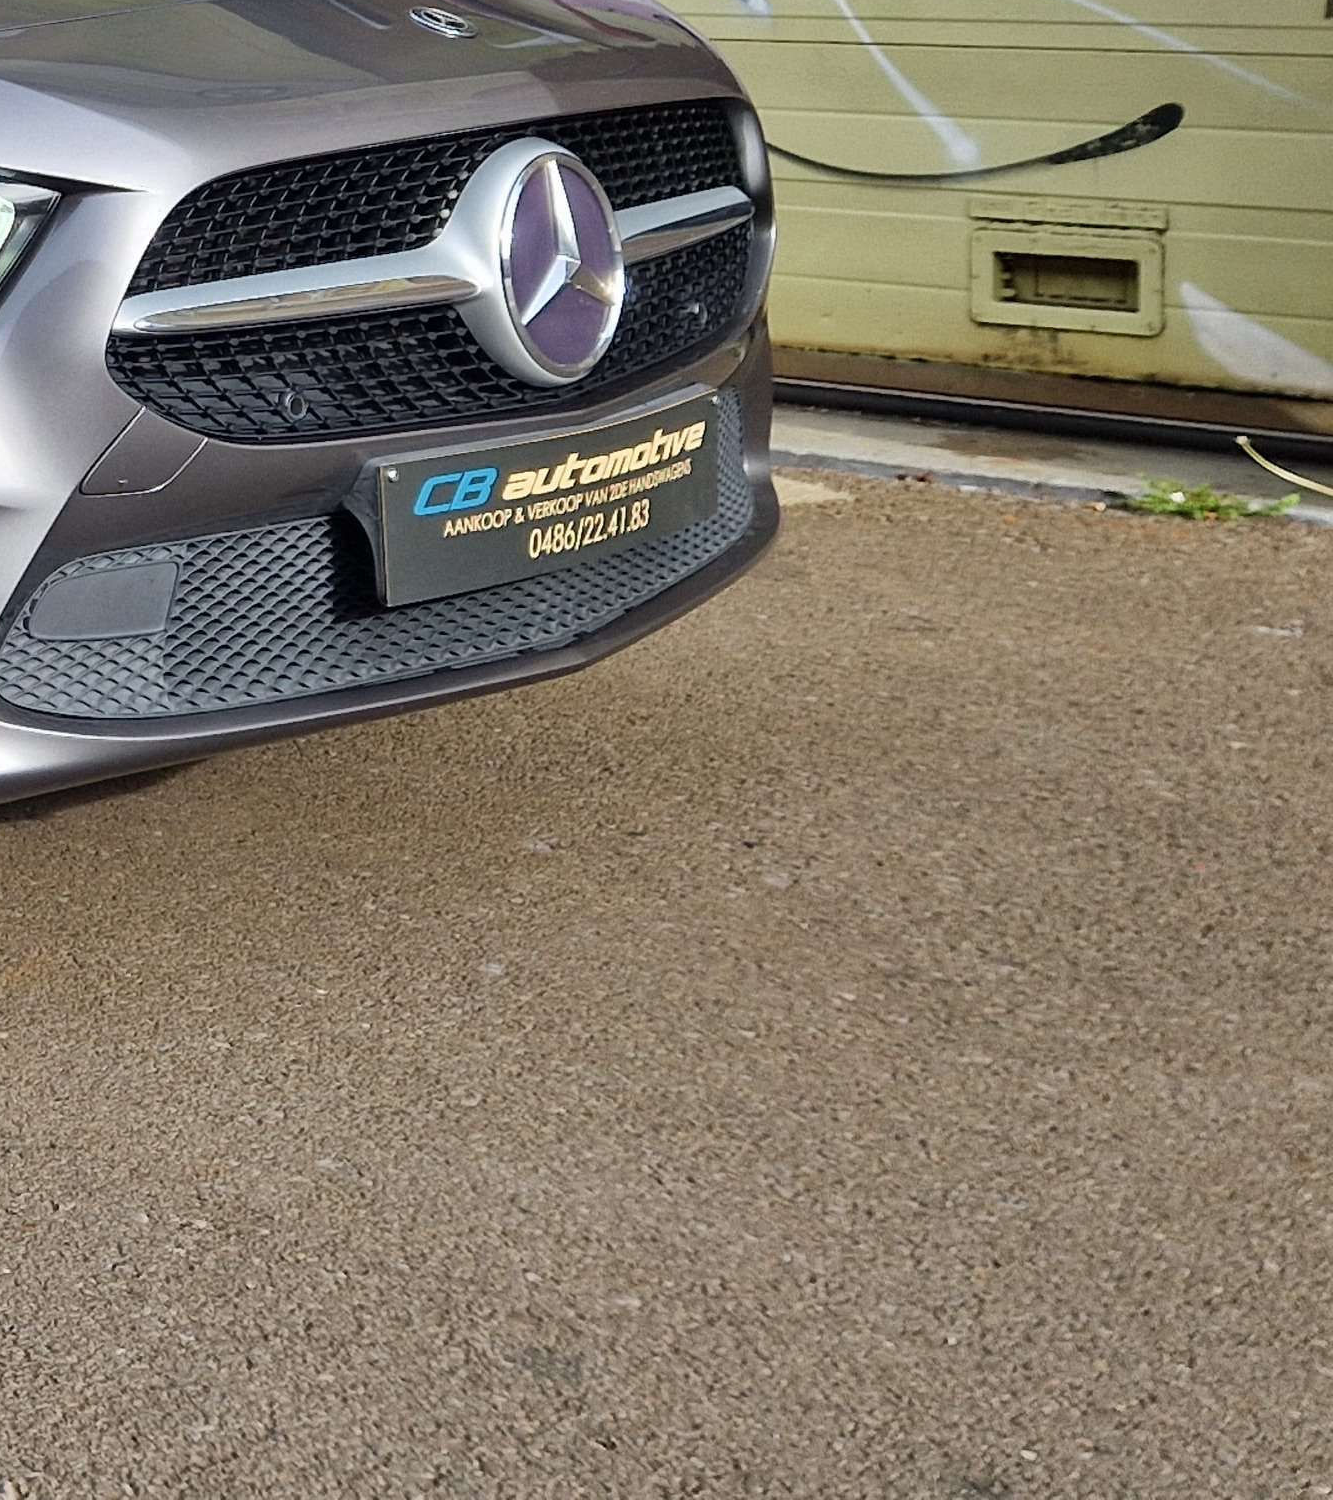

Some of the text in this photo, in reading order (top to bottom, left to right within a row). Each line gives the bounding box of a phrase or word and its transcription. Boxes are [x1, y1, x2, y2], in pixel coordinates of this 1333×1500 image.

[413, 420, 706, 516] CB automotive
[443, 508, 513, 539] AANKOOP
[514, 506, 525, 525] &
[527, 492, 584, 522] VERKOOP
[585, 486, 609, 508] VAN
[529, 498, 651, 560] 0486/22.41.83
